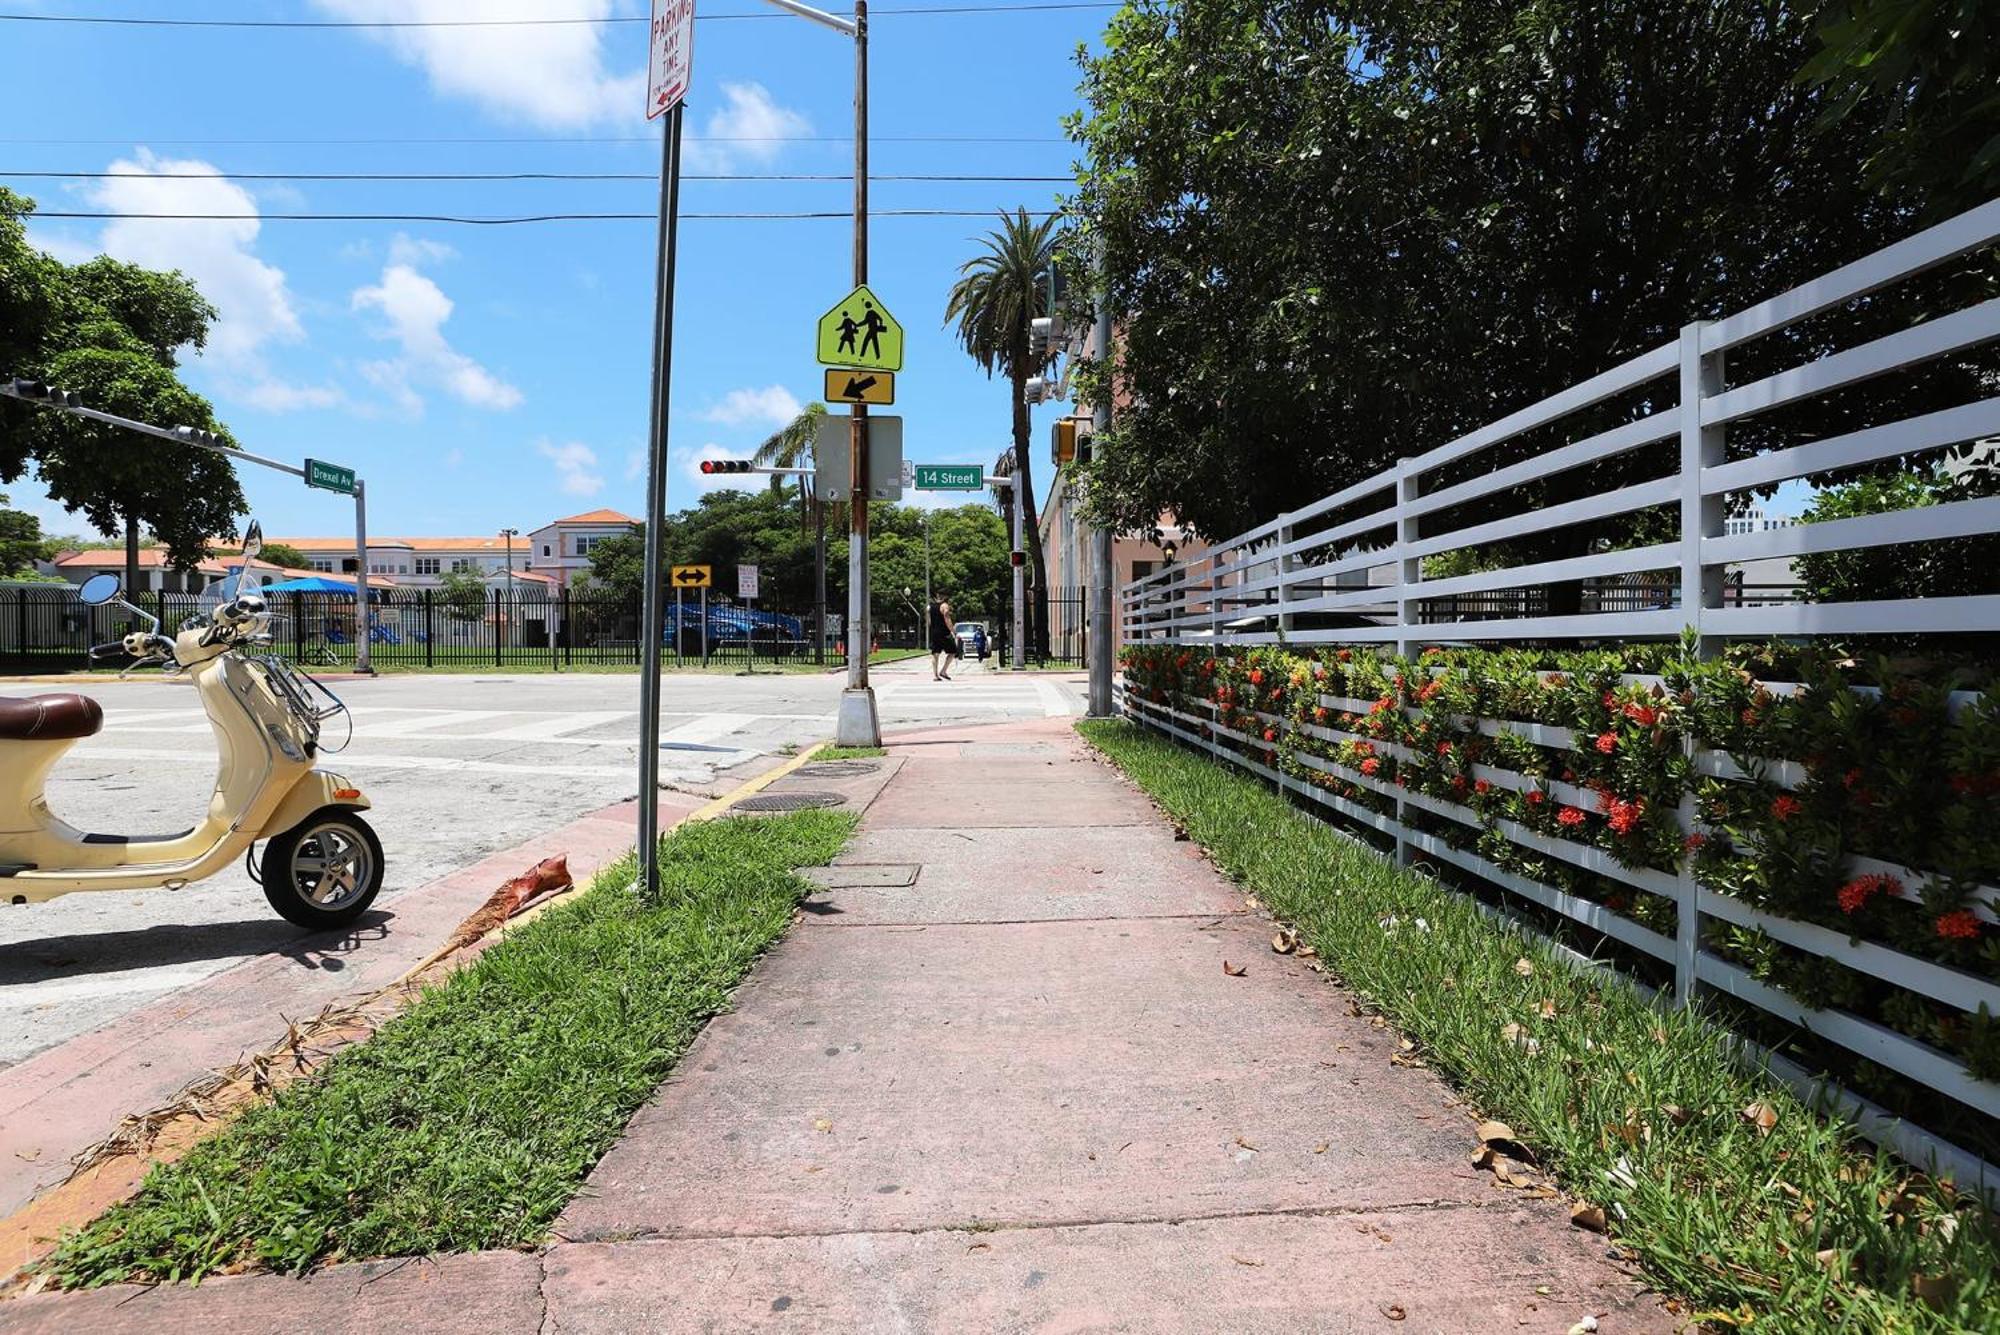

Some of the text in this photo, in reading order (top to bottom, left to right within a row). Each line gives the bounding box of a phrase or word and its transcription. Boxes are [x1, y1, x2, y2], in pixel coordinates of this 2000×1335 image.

[653, 0, 692, 41] PARKING
[663, 29, 680, 55] ANY
[663, 50, 679, 76] TIME
[313, 467, 352, 487] Drexel Av
[923, 471, 938, 484] 14
[940, 472, 974, 484] Street
